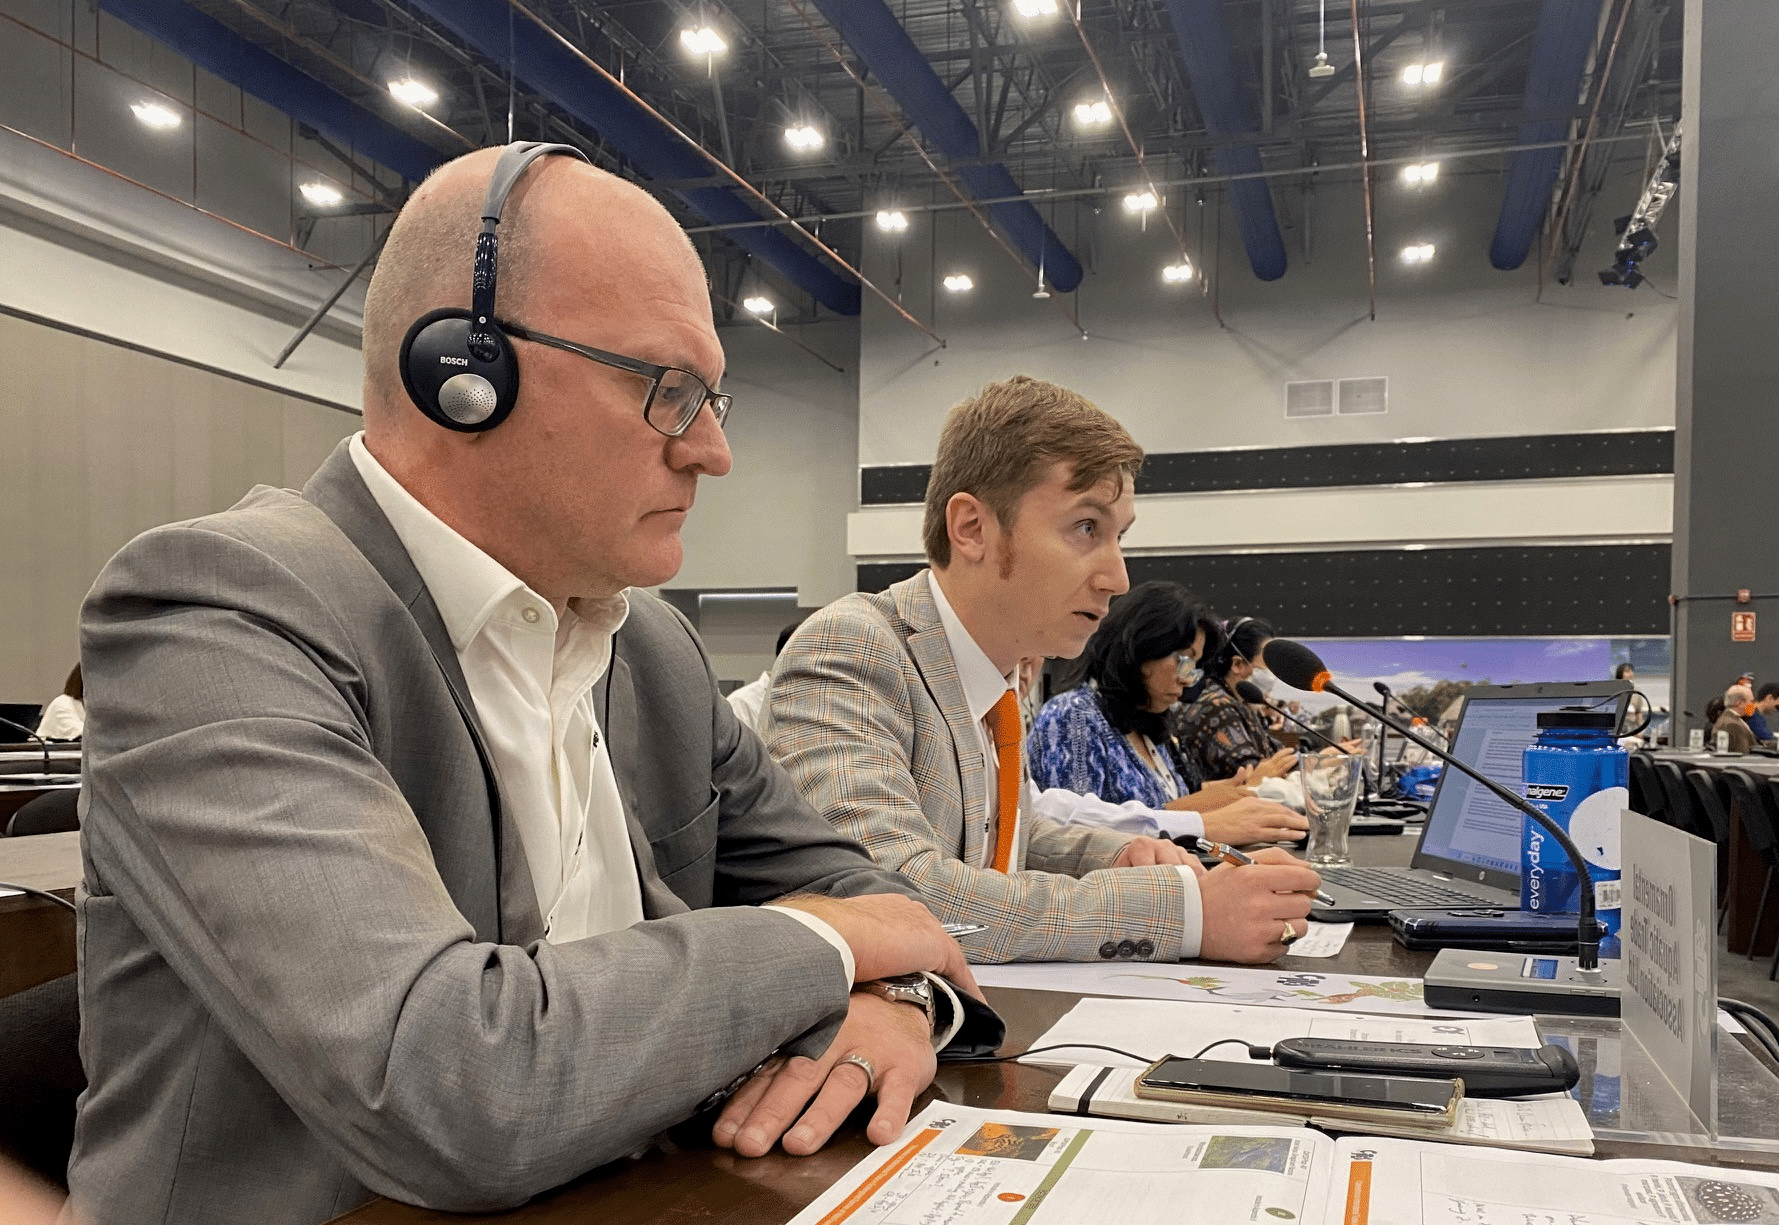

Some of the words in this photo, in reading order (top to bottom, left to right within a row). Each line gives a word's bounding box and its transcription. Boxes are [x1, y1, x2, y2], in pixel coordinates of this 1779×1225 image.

[440, 356, 468, 367] BOSCH
[1527, 786, 1564, 799] nalgene
[1527, 828, 1545, 910] everyday
